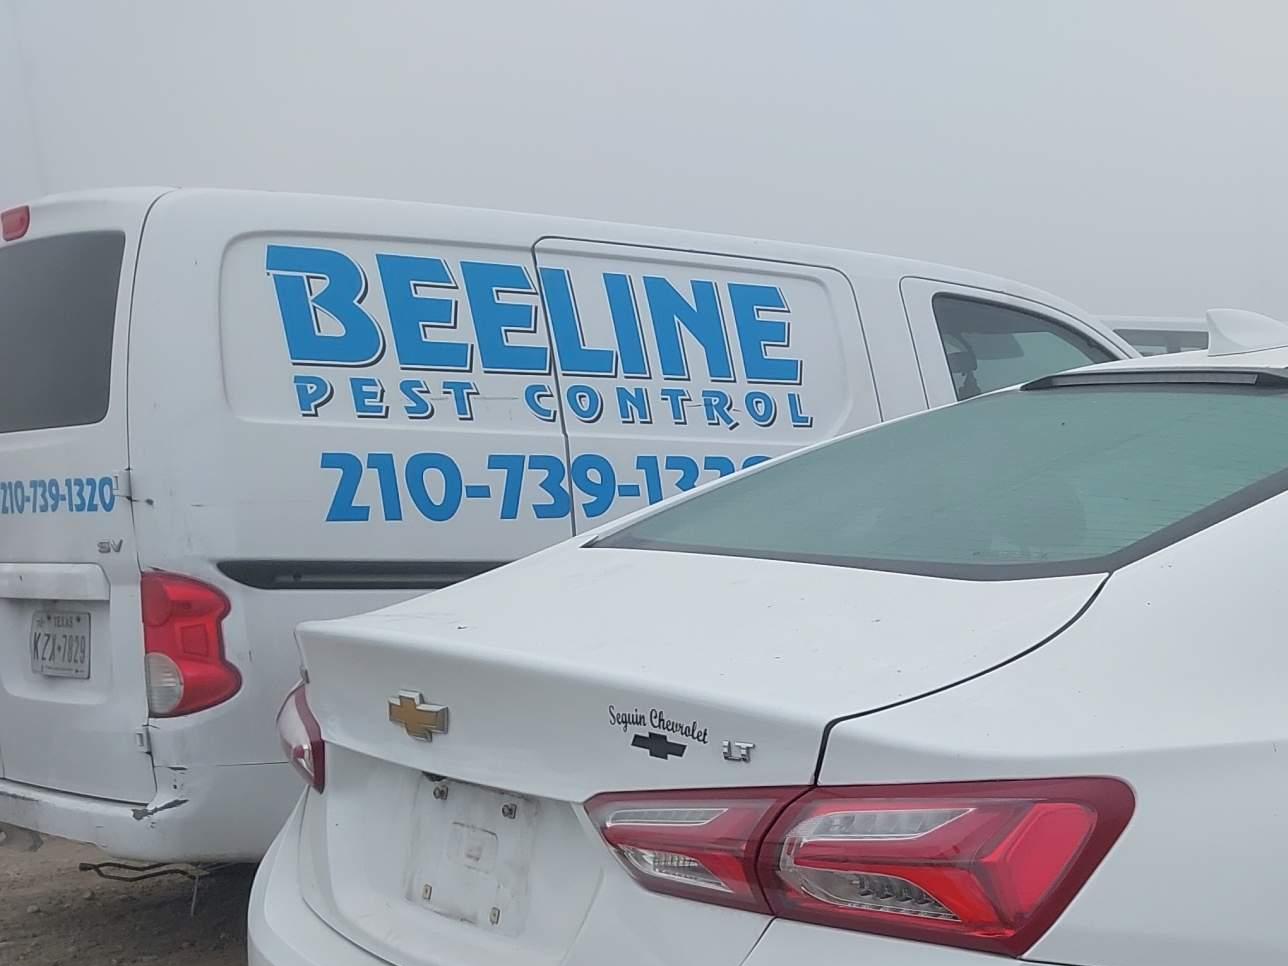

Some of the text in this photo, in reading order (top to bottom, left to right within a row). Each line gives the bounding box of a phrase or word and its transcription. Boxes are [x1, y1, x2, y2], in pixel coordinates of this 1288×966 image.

[266, 244, 803, 385] BEELINE
[293, 374, 814, 430] PEST CONTROL
[0, 476, 116, 515] 210-739-1320
[97, 539, 123, 554] SV
[608, 704, 709, 745] Seguin Chevrolet
[722, 740, 755, 763] LT
